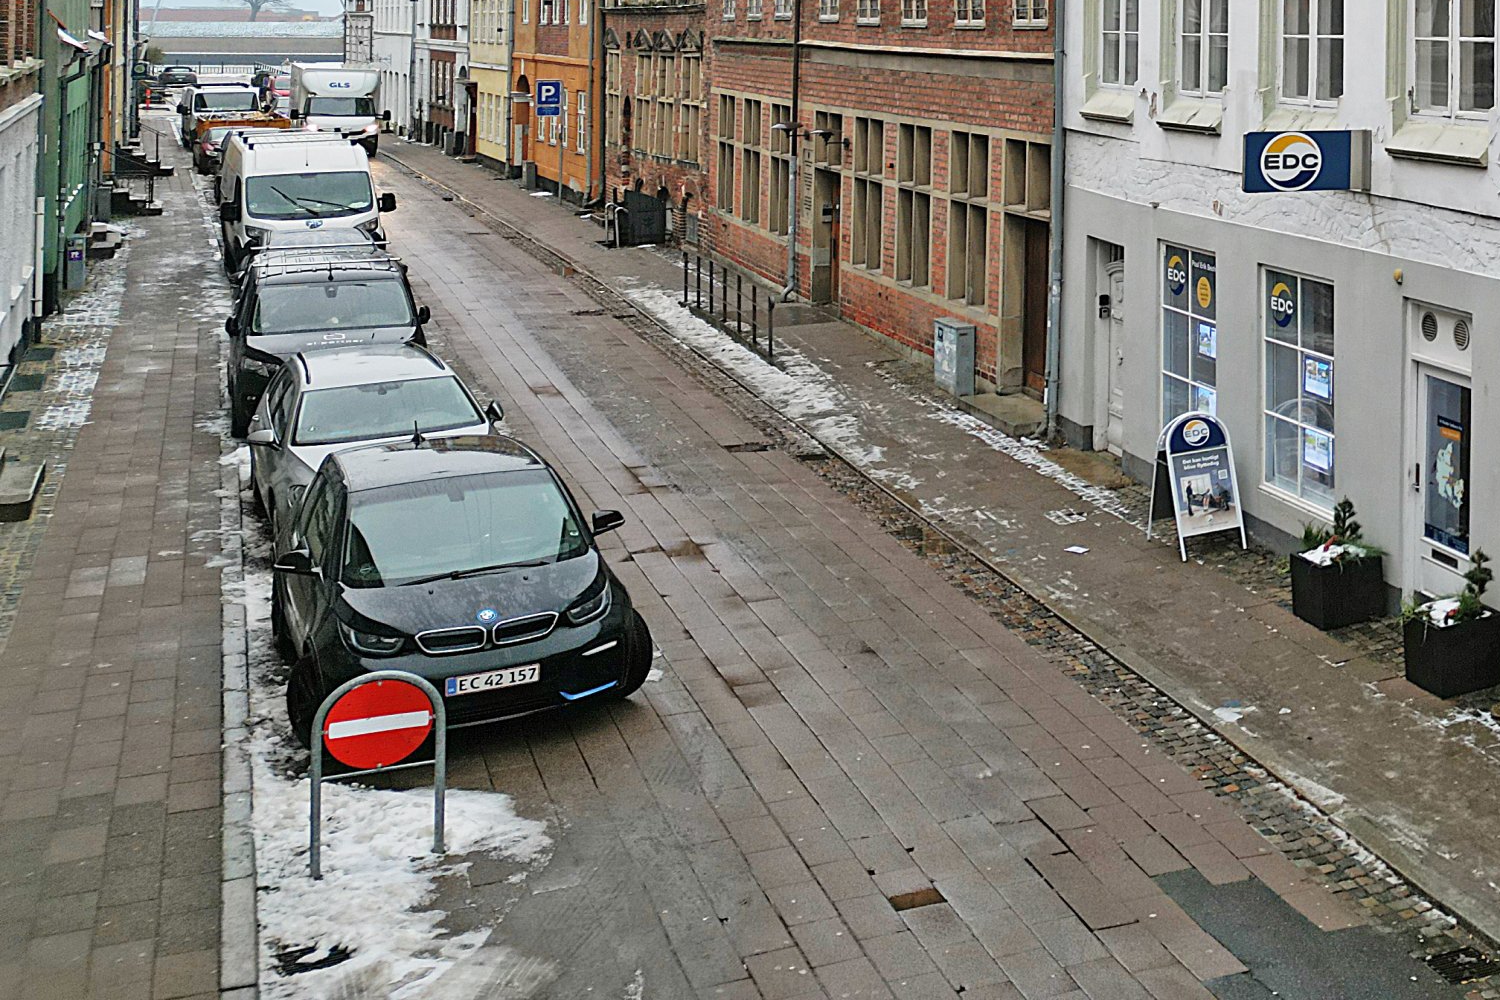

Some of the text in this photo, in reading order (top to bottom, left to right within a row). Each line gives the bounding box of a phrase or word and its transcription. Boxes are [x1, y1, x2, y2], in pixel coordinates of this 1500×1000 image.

[541, 85, 555, 102] P
[1264, 153, 1319, 170] EDC
[1167, 268, 1186, 284] EDC
[1270, 296, 1294, 314] EDC
[1185, 428, 1208, 438] EDC
[459, 667, 536, 691] EC 42 157
